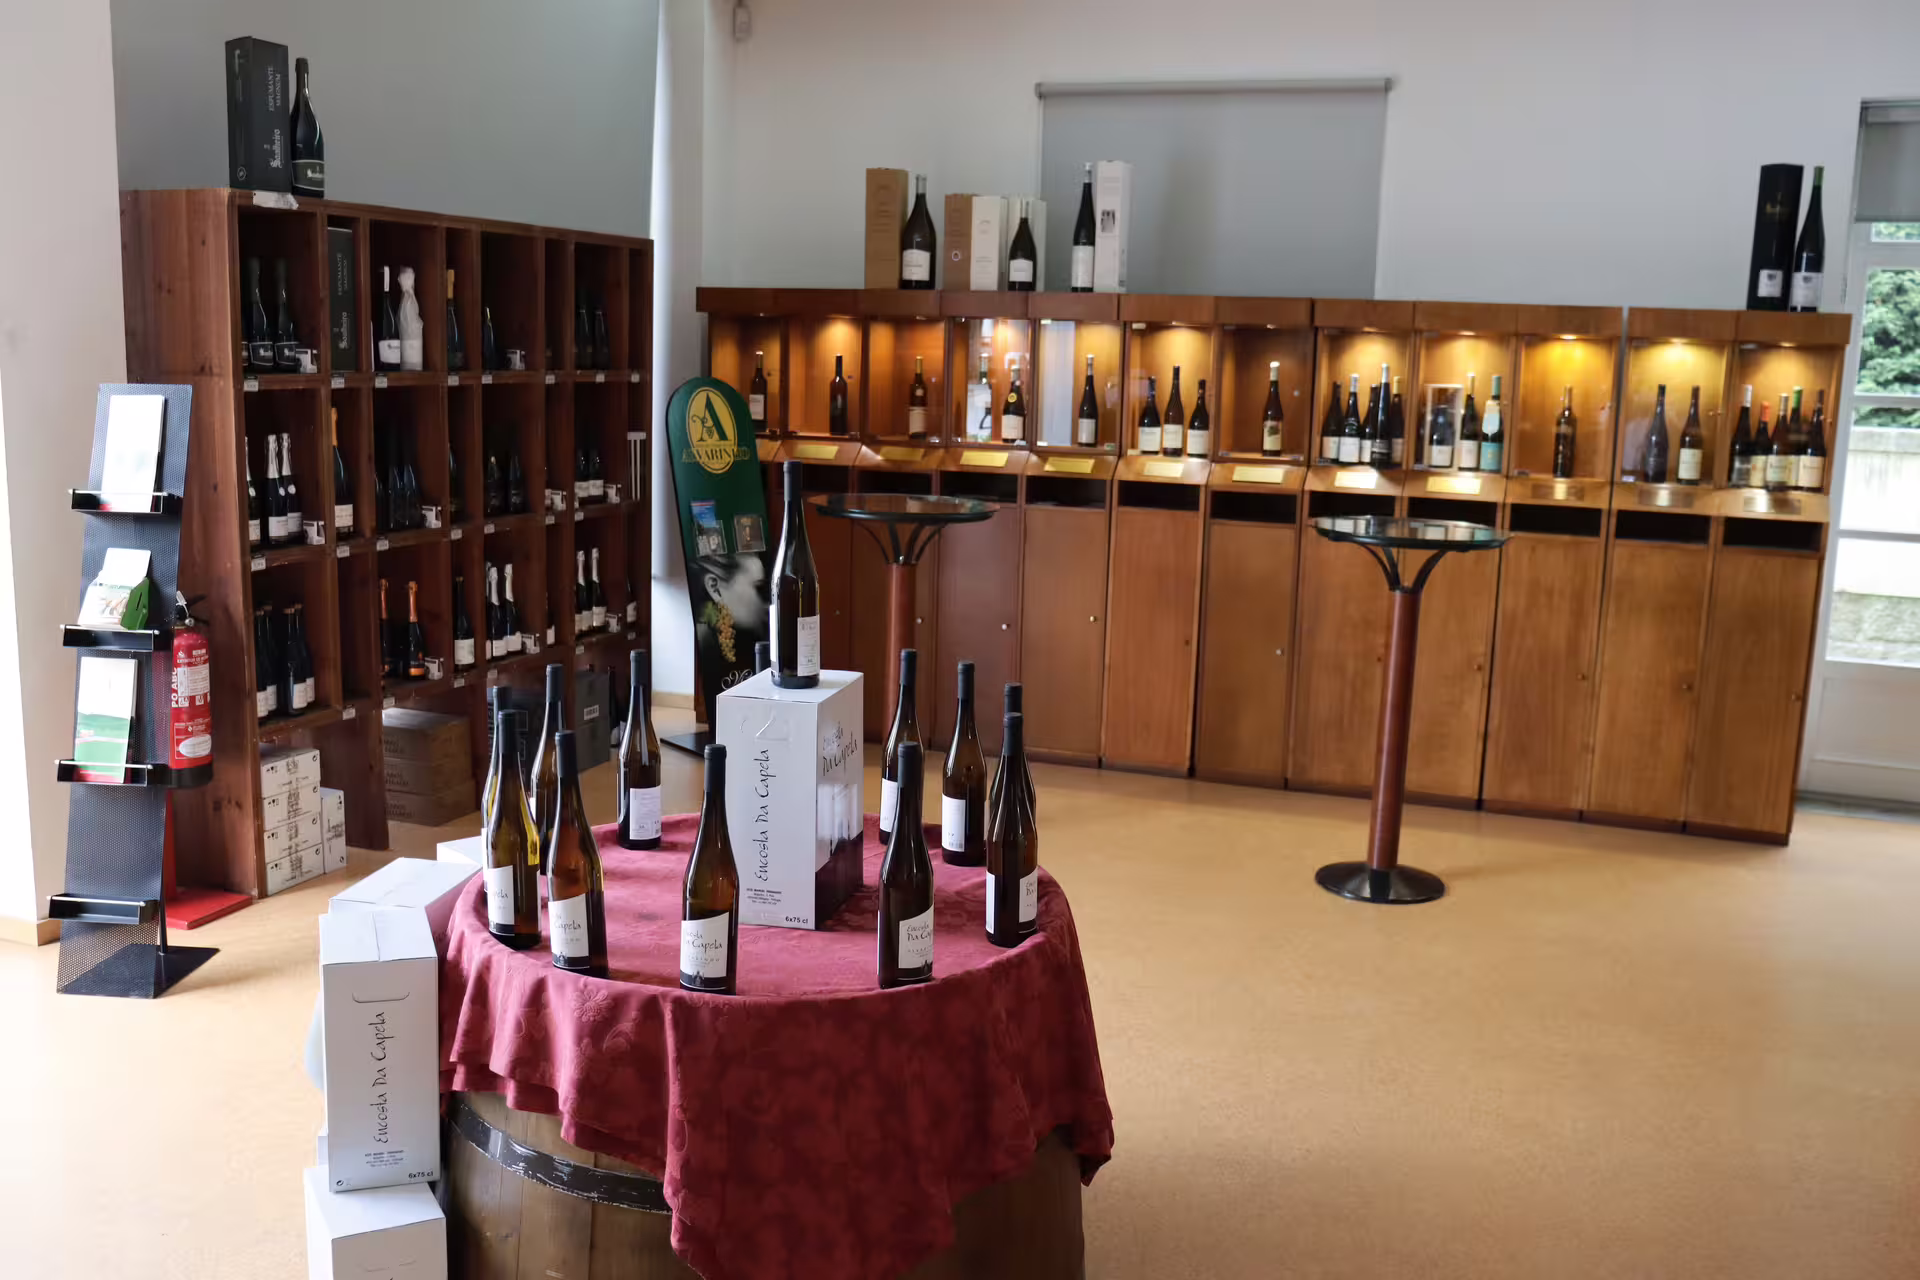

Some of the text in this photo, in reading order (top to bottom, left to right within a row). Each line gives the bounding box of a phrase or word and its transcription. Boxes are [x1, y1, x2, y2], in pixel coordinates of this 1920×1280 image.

[754, 748, 777, 799] Capela
[754, 803, 769, 825] Da
[752, 829, 769, 882] Encosta
[785, 915, 801, 924] 6x75
[690, 938, 723, 953] Capela
[368, 1011, 394, 1062] Capela
[372, 1066, 387, 1088] Da
[370, 1091, 389, 1144] Encosta
[408, 1171, 426, 1179] 6x75
